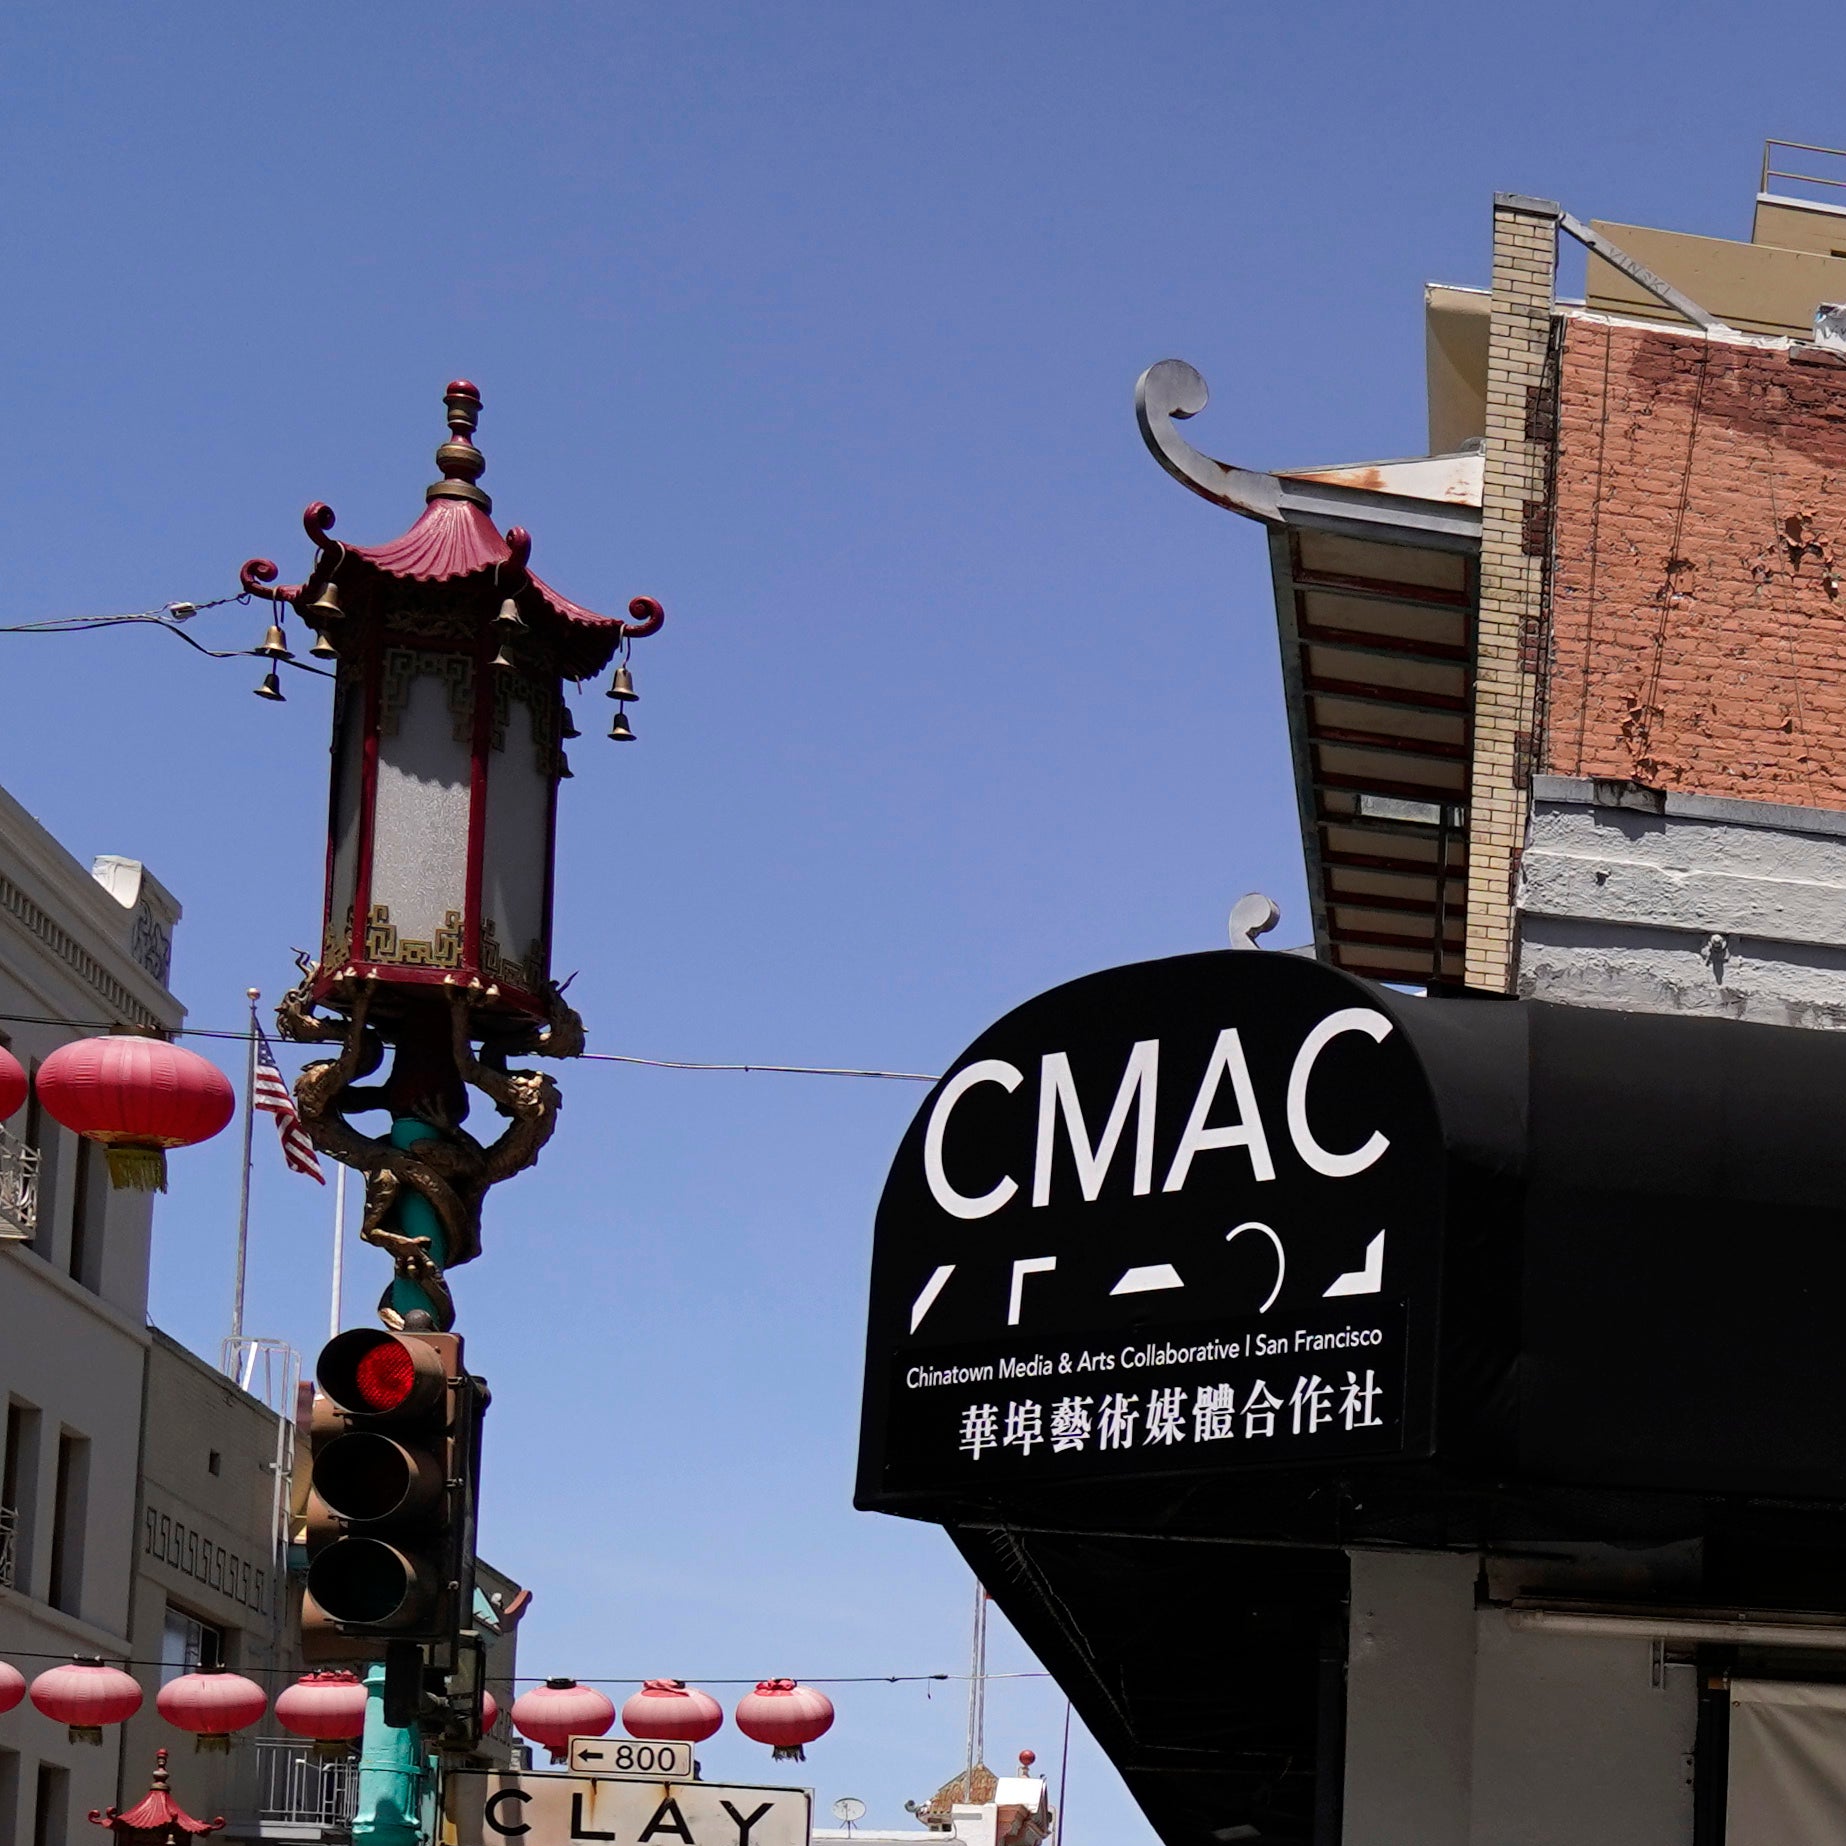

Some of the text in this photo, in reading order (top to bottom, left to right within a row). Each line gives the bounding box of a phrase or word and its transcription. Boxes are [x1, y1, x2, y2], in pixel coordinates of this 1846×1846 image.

[924, 1007, 1393, 1220] CMAC
[906, 1365, 993, 1389] Chinatown
[998, 1355, 1053, 1379] Media
[1058, 1355, 1073, 1373] &
[1076, 1350, 1115, 1372] Arts
[1120, 1341, 1240, 1369] Collaborative
[1255, 1333, 1289, 1356] San
[1295, 1325, 1383, 1352] Francisco
[959, 1369, 1383, 1461] 華埠藝術媒體合作社
[615, 1745, 676, 1772] 800
